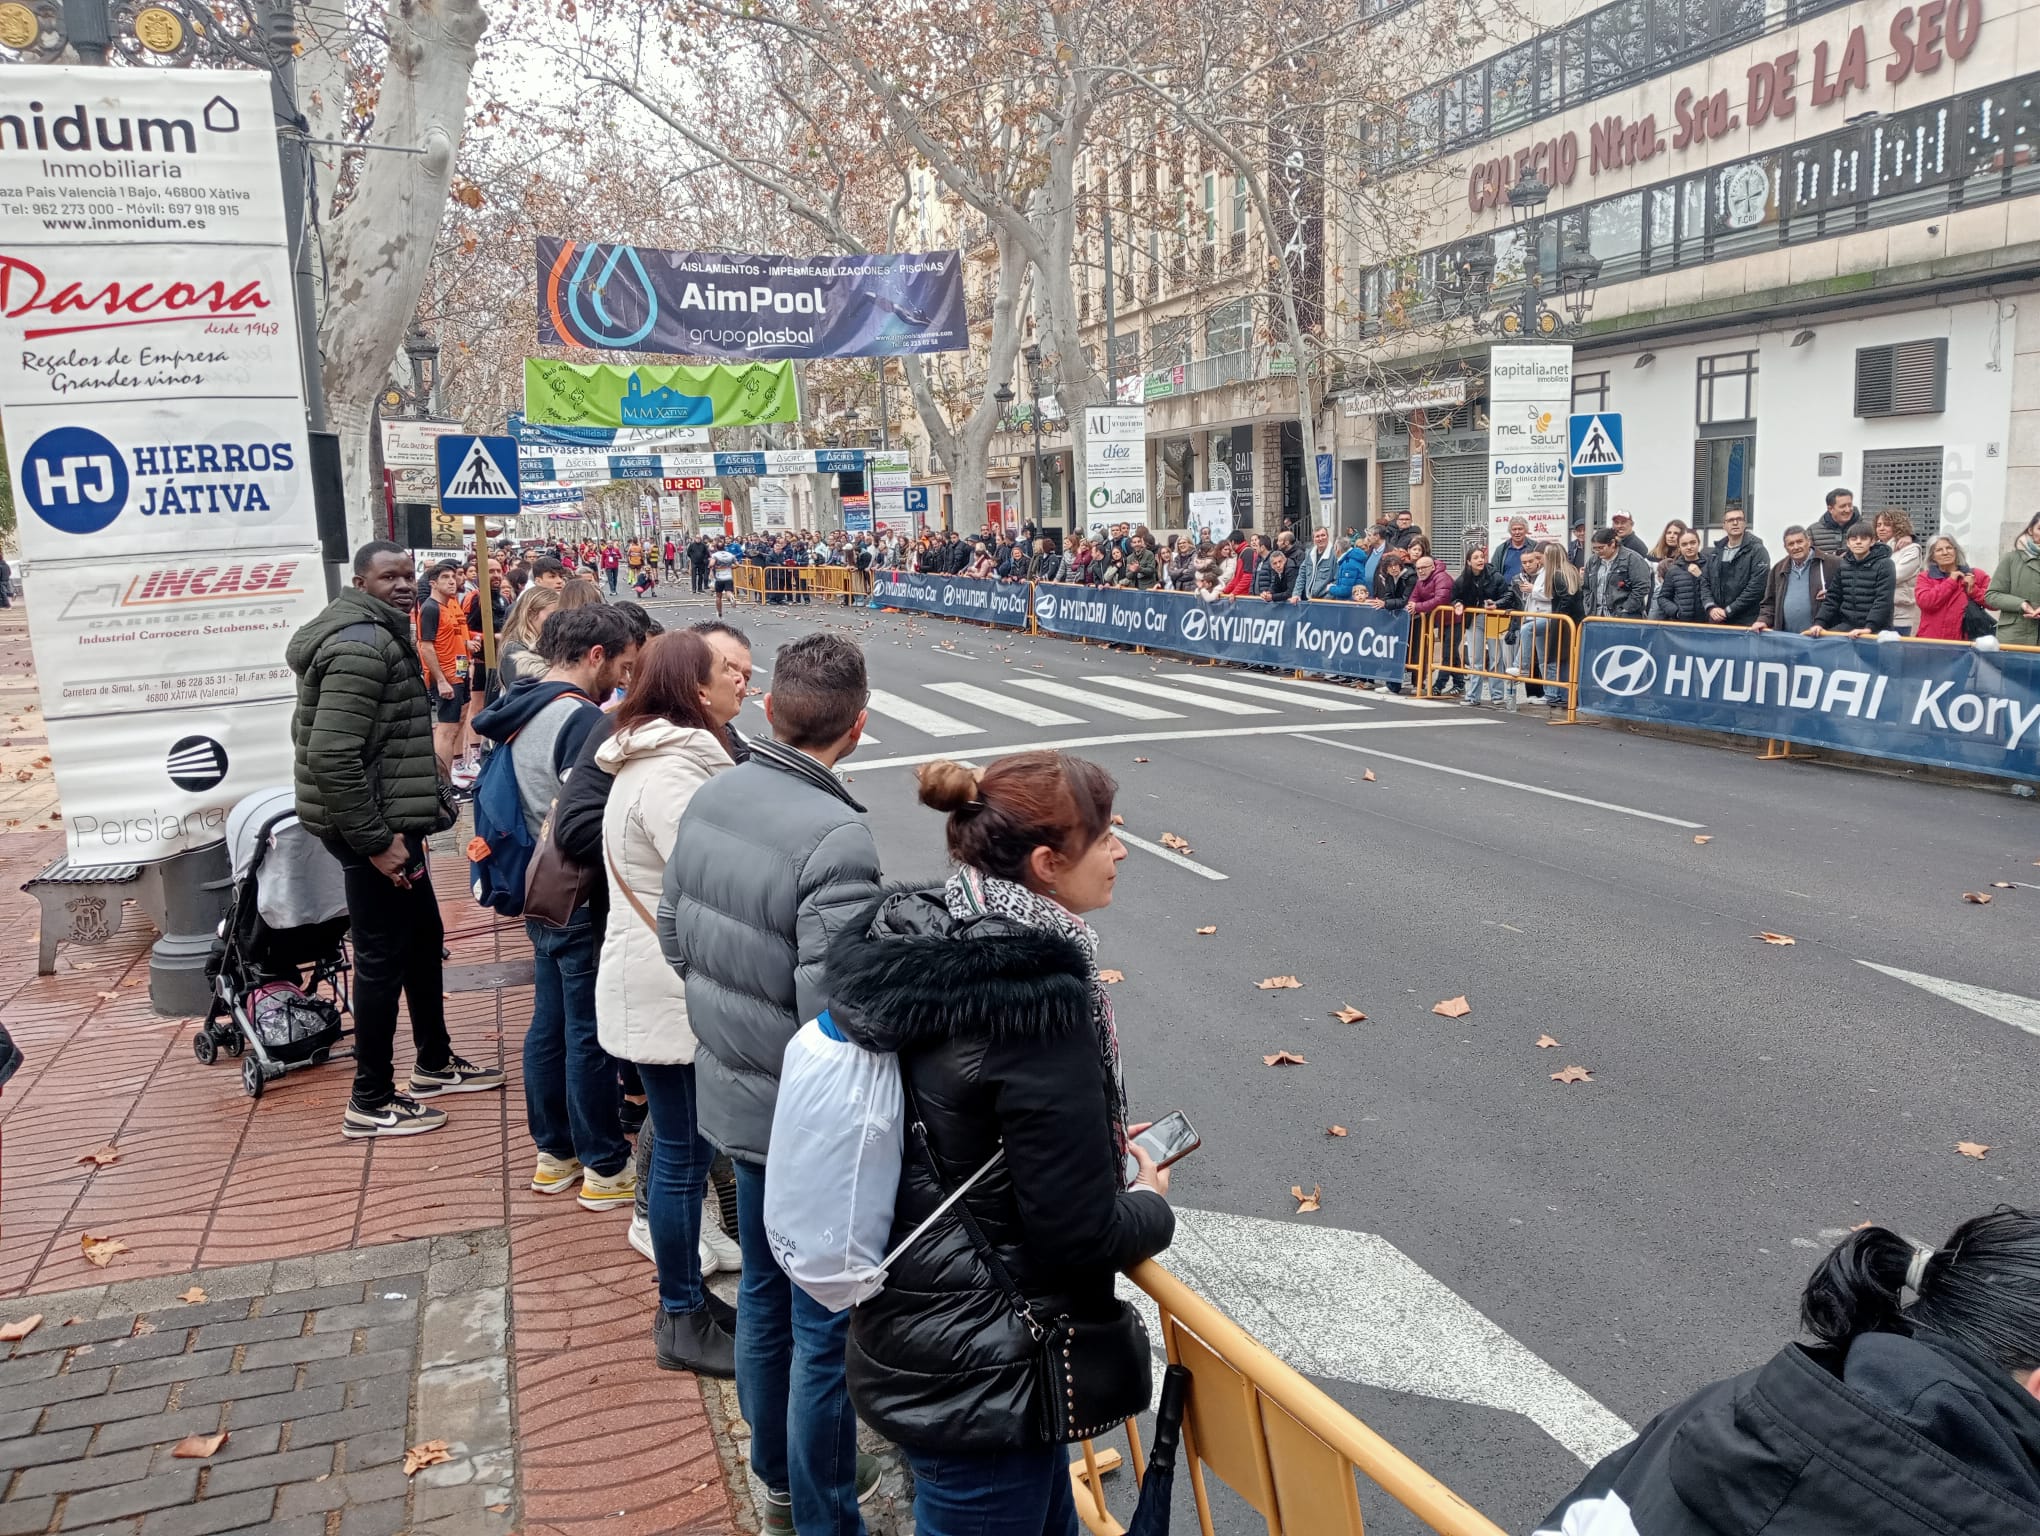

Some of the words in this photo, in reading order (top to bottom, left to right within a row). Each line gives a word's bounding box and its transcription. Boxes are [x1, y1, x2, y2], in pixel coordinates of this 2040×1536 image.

[1467, 131, 1577, 214] COLEGIO
[1589, 113, 1664, 177] Ntra.
[1672, 86, 1738, 150] Sra.
[1745, 50, 1799, 127] DE
[1811, 25, 1867, 107] LA
[1885, 0, 1982, 83] SEO
[43, 159, 183, 179] Inmobiliaria
[128, 187, 162, 202] Bajo,
[164, 187, 206, 200] 46800
[3, 203, 30, 215] Tel:
[32, 204, 57, 215] 962
[60, 204, 87, 216] 273
[89, 204, 115, 216] 000
[127, 202, 166, 216] Móvil:
[168, 203, 192, 216] 697
[194, 204, 221, 216] 918
[223, 204, 240, 216] 915
[43, 215, 207, 231] www.inmonidum.es
[680, 261, 760, 277] AISLAMIENTOS
[768, 264, 891, 278] IMPERMEABILIZACIONES
[898, 261, 945, 275] PISCINAS
[0, 255, 271, 319] Dascosa
[680, 282, 827, 315] AimPool
[204, 323, 241, 335] desde
[244, 321, 280, 336] 1948
[690, 325, 814, 348] grupoplasbal
[22, 349, 102, 375] Regalos
[102, 347, 132, 366] de
[139, 347, 230, 366] Empresa
[1494, 362, 1569, 379] kapitalia.net
[51, 371, 142, 395] Grandes
[147, 372, 205, 387] vinos
[542, 367, 557, 380] Club
[132, 443, 295, 477] HIERROS
[538, 446, 584, 455] Envases
[566, 458, 597, 468] ASCIRES
[620, 456, 651, 466] ASCIRES
[673, 456, 703, 466] ASCIRES
[726, 455, 755, 464] ASCIRES
[777, 453, 805, 463] ASCIRES
[826, 451, 854, 461] ASCIRES
[34, 454, 116, 507] HJ
[568, 470, 600, 479] ASCIRES
[622, 467, 653, 476] ASCIRES
[675, 467, 706, 476] ASCIRES
[727, 465, 757, 474] ASCIRES
[778, 464, 806, 473] ASCIRES
[827, 462, 855, 471] ASCIRES
[140, 478, 271, 517] JÁTIVA
[906, 490, 923, 509] P
[139, 561, 300, 599] INCASE
[926, 586, 937, 602] Car
[955, 589, 988, 610] HYUNDAI
[1011, 596, 1026, 614] Car
[87, 606, 285, 629] CARROCERIAS
[1059, 601, 1107, 624] HYUNDAI
[1111, 604, 1142, 633] Koryo
[1144, 607, 1168, 633] Car
[78, 631, 136, 645] Industrial
[139, 628, 200, 641] Carrocera
[202, 622, 269, 636] Setabense,
[272, 619, 291, 630] s.l.
[1209, 614, 1284, 647] HYUNDAI
[1294, 621, 1355, 666] Koryo
[1356, 628, 1399, 659] Car
[63, 687, 97, 698] Carretera
[99, 685, 109, 695] de
[176, 679, 188, 689] 96
[188, 678, 203, 688] 228
[205, 676, 215, 686] 35
[216, 675, 227, 685] 31
[268, 670, 278, 679] 96
[146, 693, 169, 704] 46800
[199, 686, 239, 700] (Valencia)
[1663, 653, 1889, 720] HYUNDAI
[73, 804, 236, 848] Persiana
